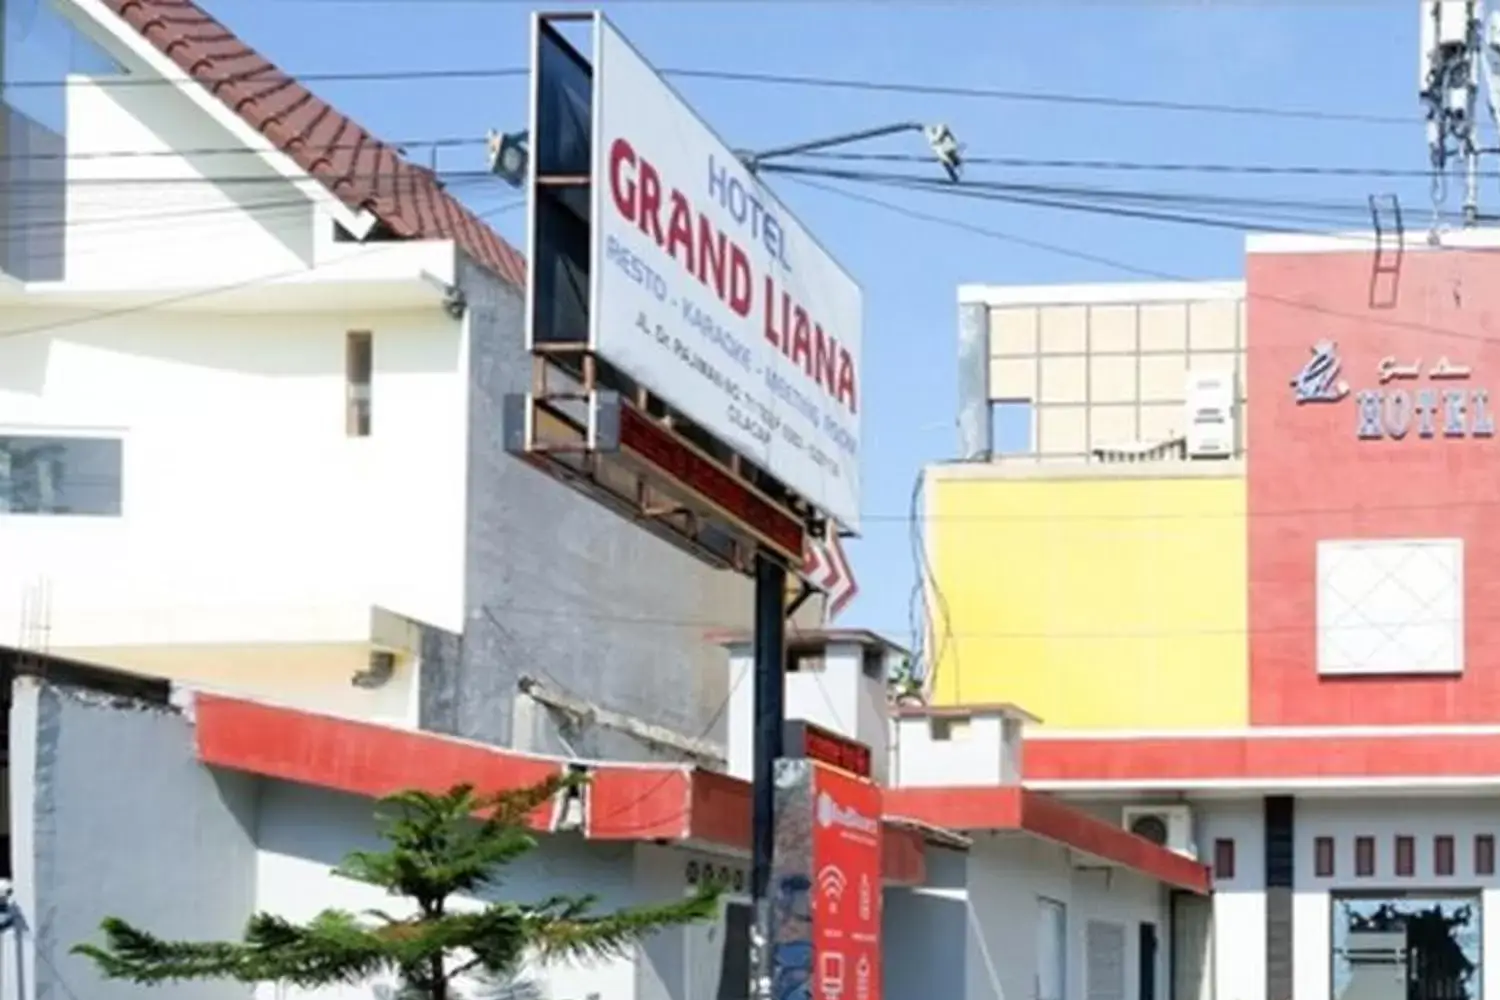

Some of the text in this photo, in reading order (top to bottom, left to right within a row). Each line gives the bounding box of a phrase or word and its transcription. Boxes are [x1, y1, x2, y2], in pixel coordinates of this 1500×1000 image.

[708, 153, 792, 272] HOTEL
[605, 233, 668, 303] RESTO
[609, 137, 857, 415] GRAND LIANA
[1355, 387, 1496, 441] HOTEL
